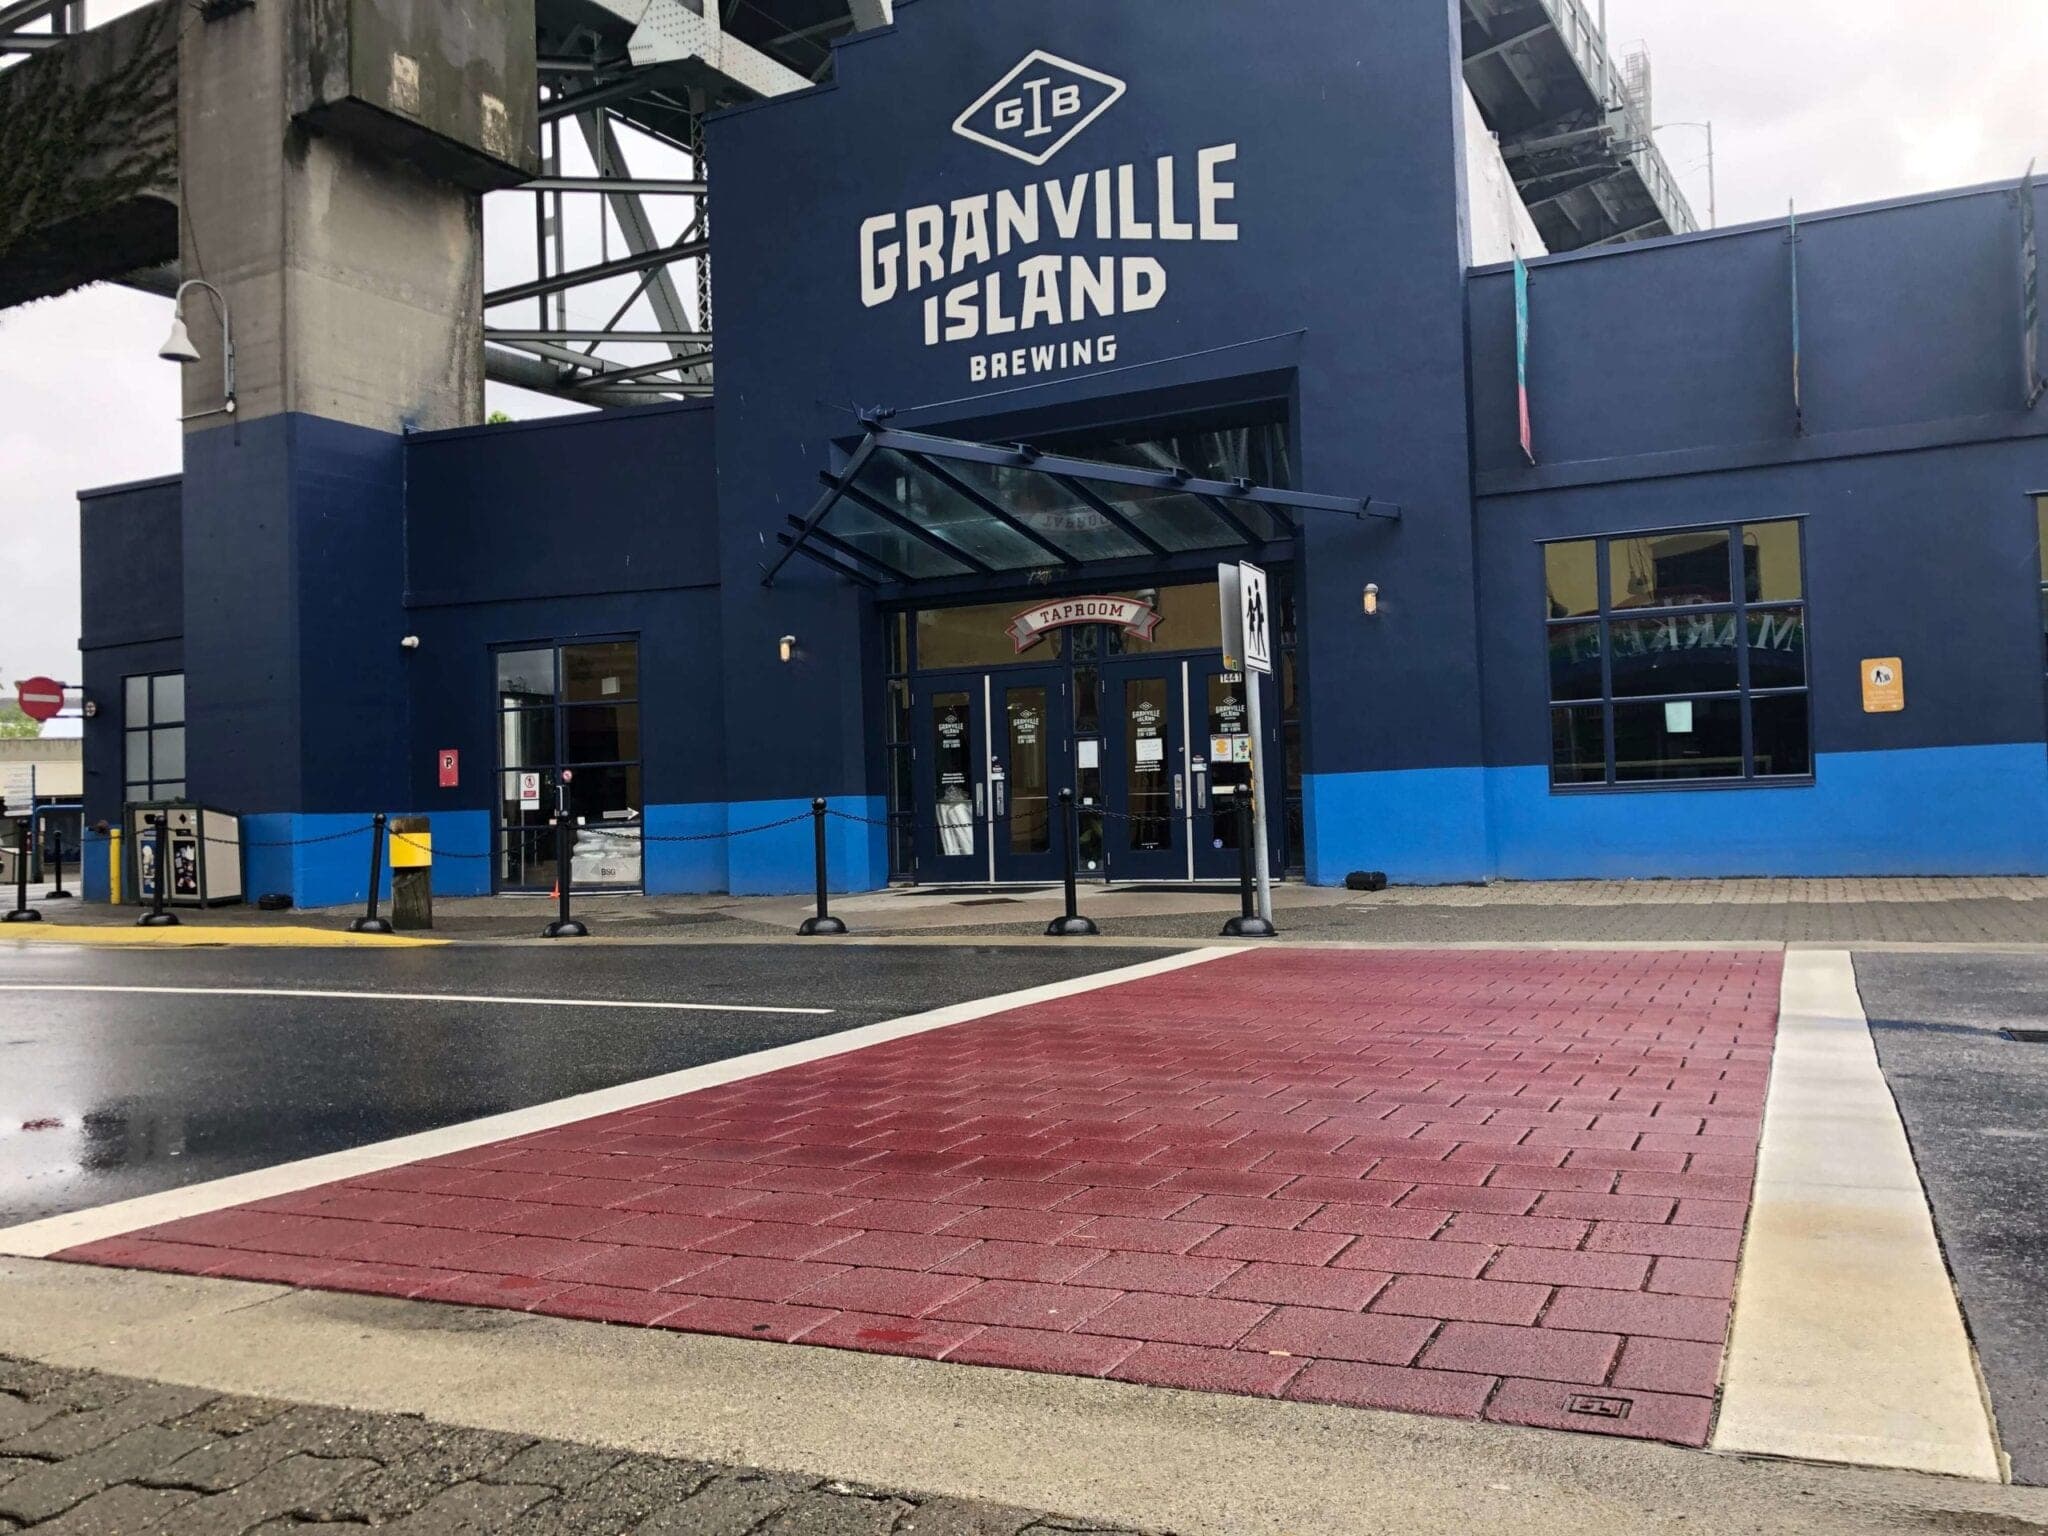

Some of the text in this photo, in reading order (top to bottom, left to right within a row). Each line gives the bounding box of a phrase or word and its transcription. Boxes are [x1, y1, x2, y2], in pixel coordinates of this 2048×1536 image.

[995, 77, 1080, 137] GIB
[860, 143, 1238, 307] GRANVILLE
[924, 255, 1166, 345] ISLAND
[970, 335, 1117, 381] BREWING
[1040, 603, 1124, 624] TAPROOM
